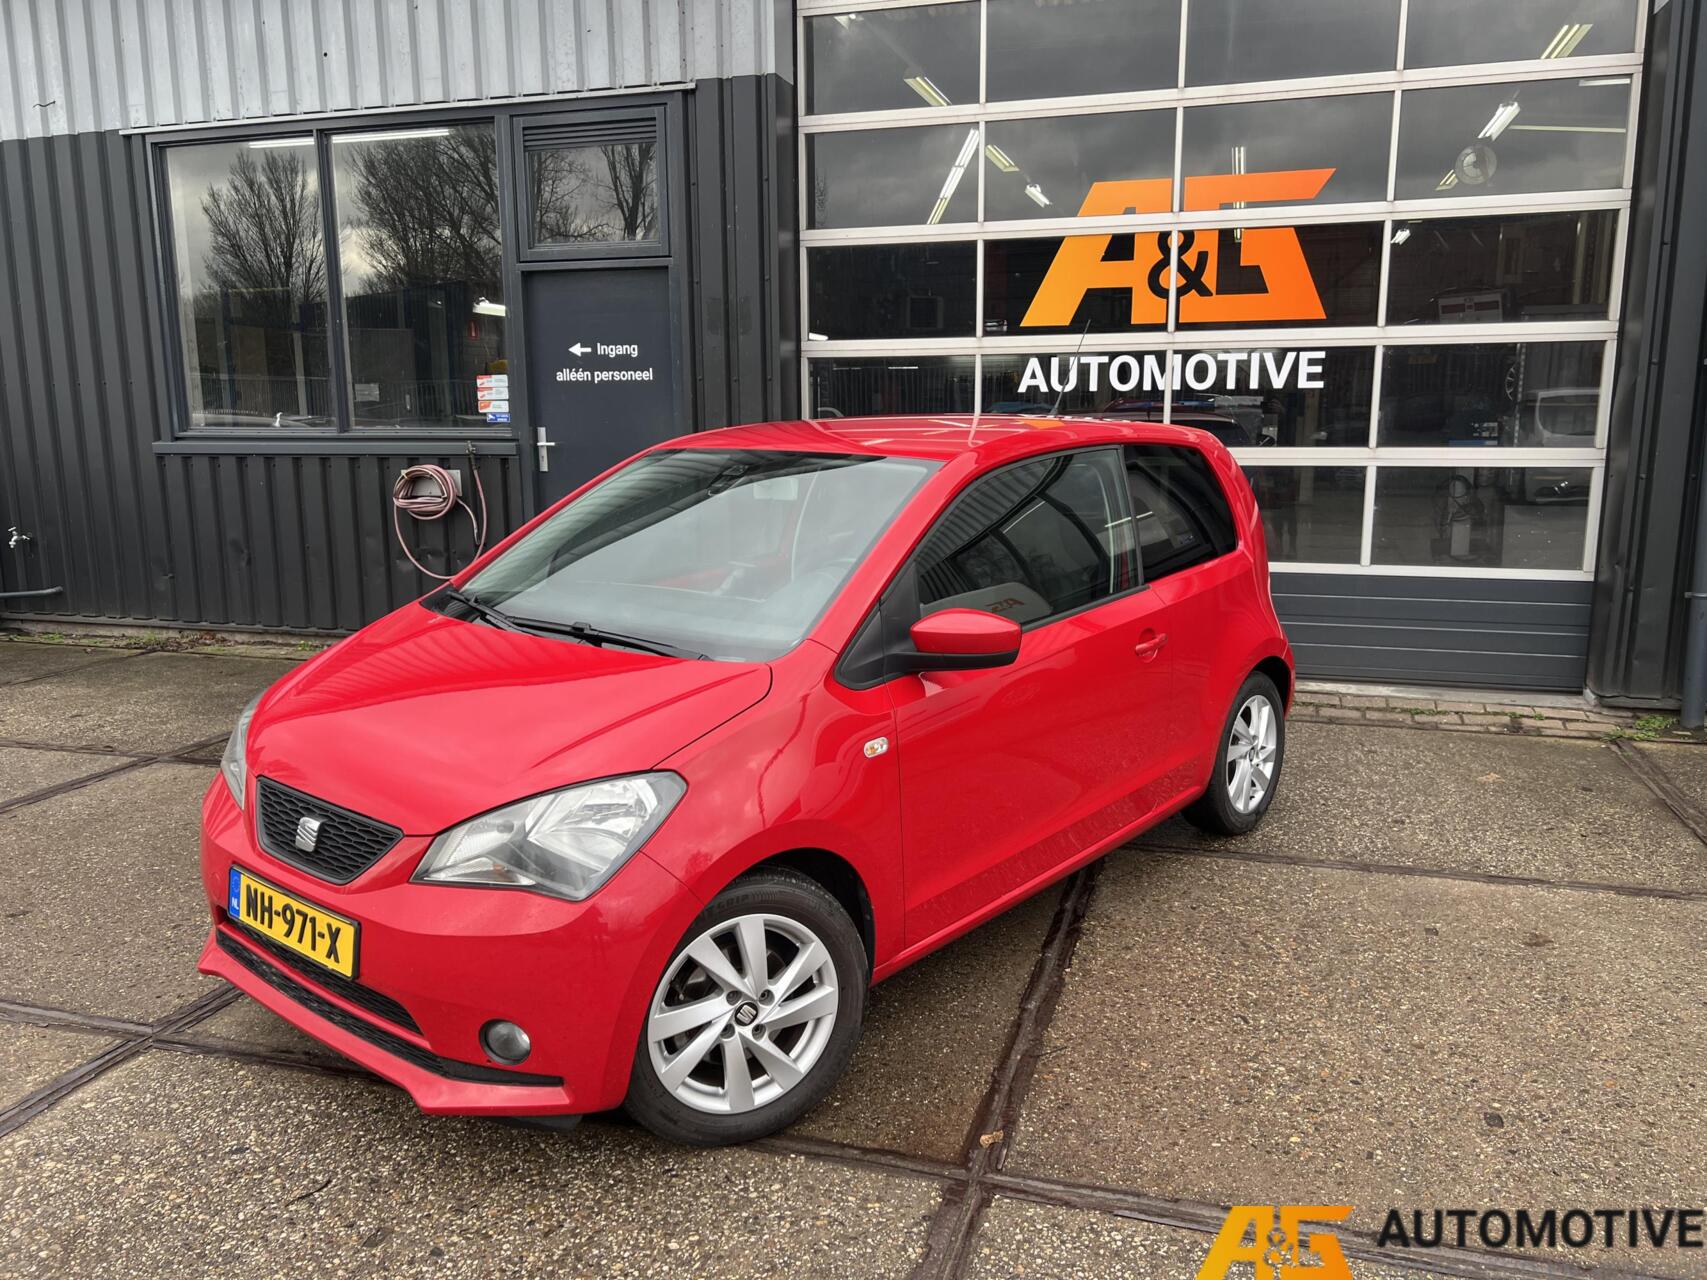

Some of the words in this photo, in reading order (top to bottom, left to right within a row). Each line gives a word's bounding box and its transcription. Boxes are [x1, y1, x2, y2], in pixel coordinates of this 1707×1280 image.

[1019, 168, 1336, 327] A&G
[597, 342, 638, 358] Ingang
[556, 367, 591, 381] alléén
[594, 367, 653, 384] personeel
[1017, 350, 1326, 393] AUTOMOTIVE
[231, 896, 239, 910] NL
[246, 883, 341, 964] NH-971-X
